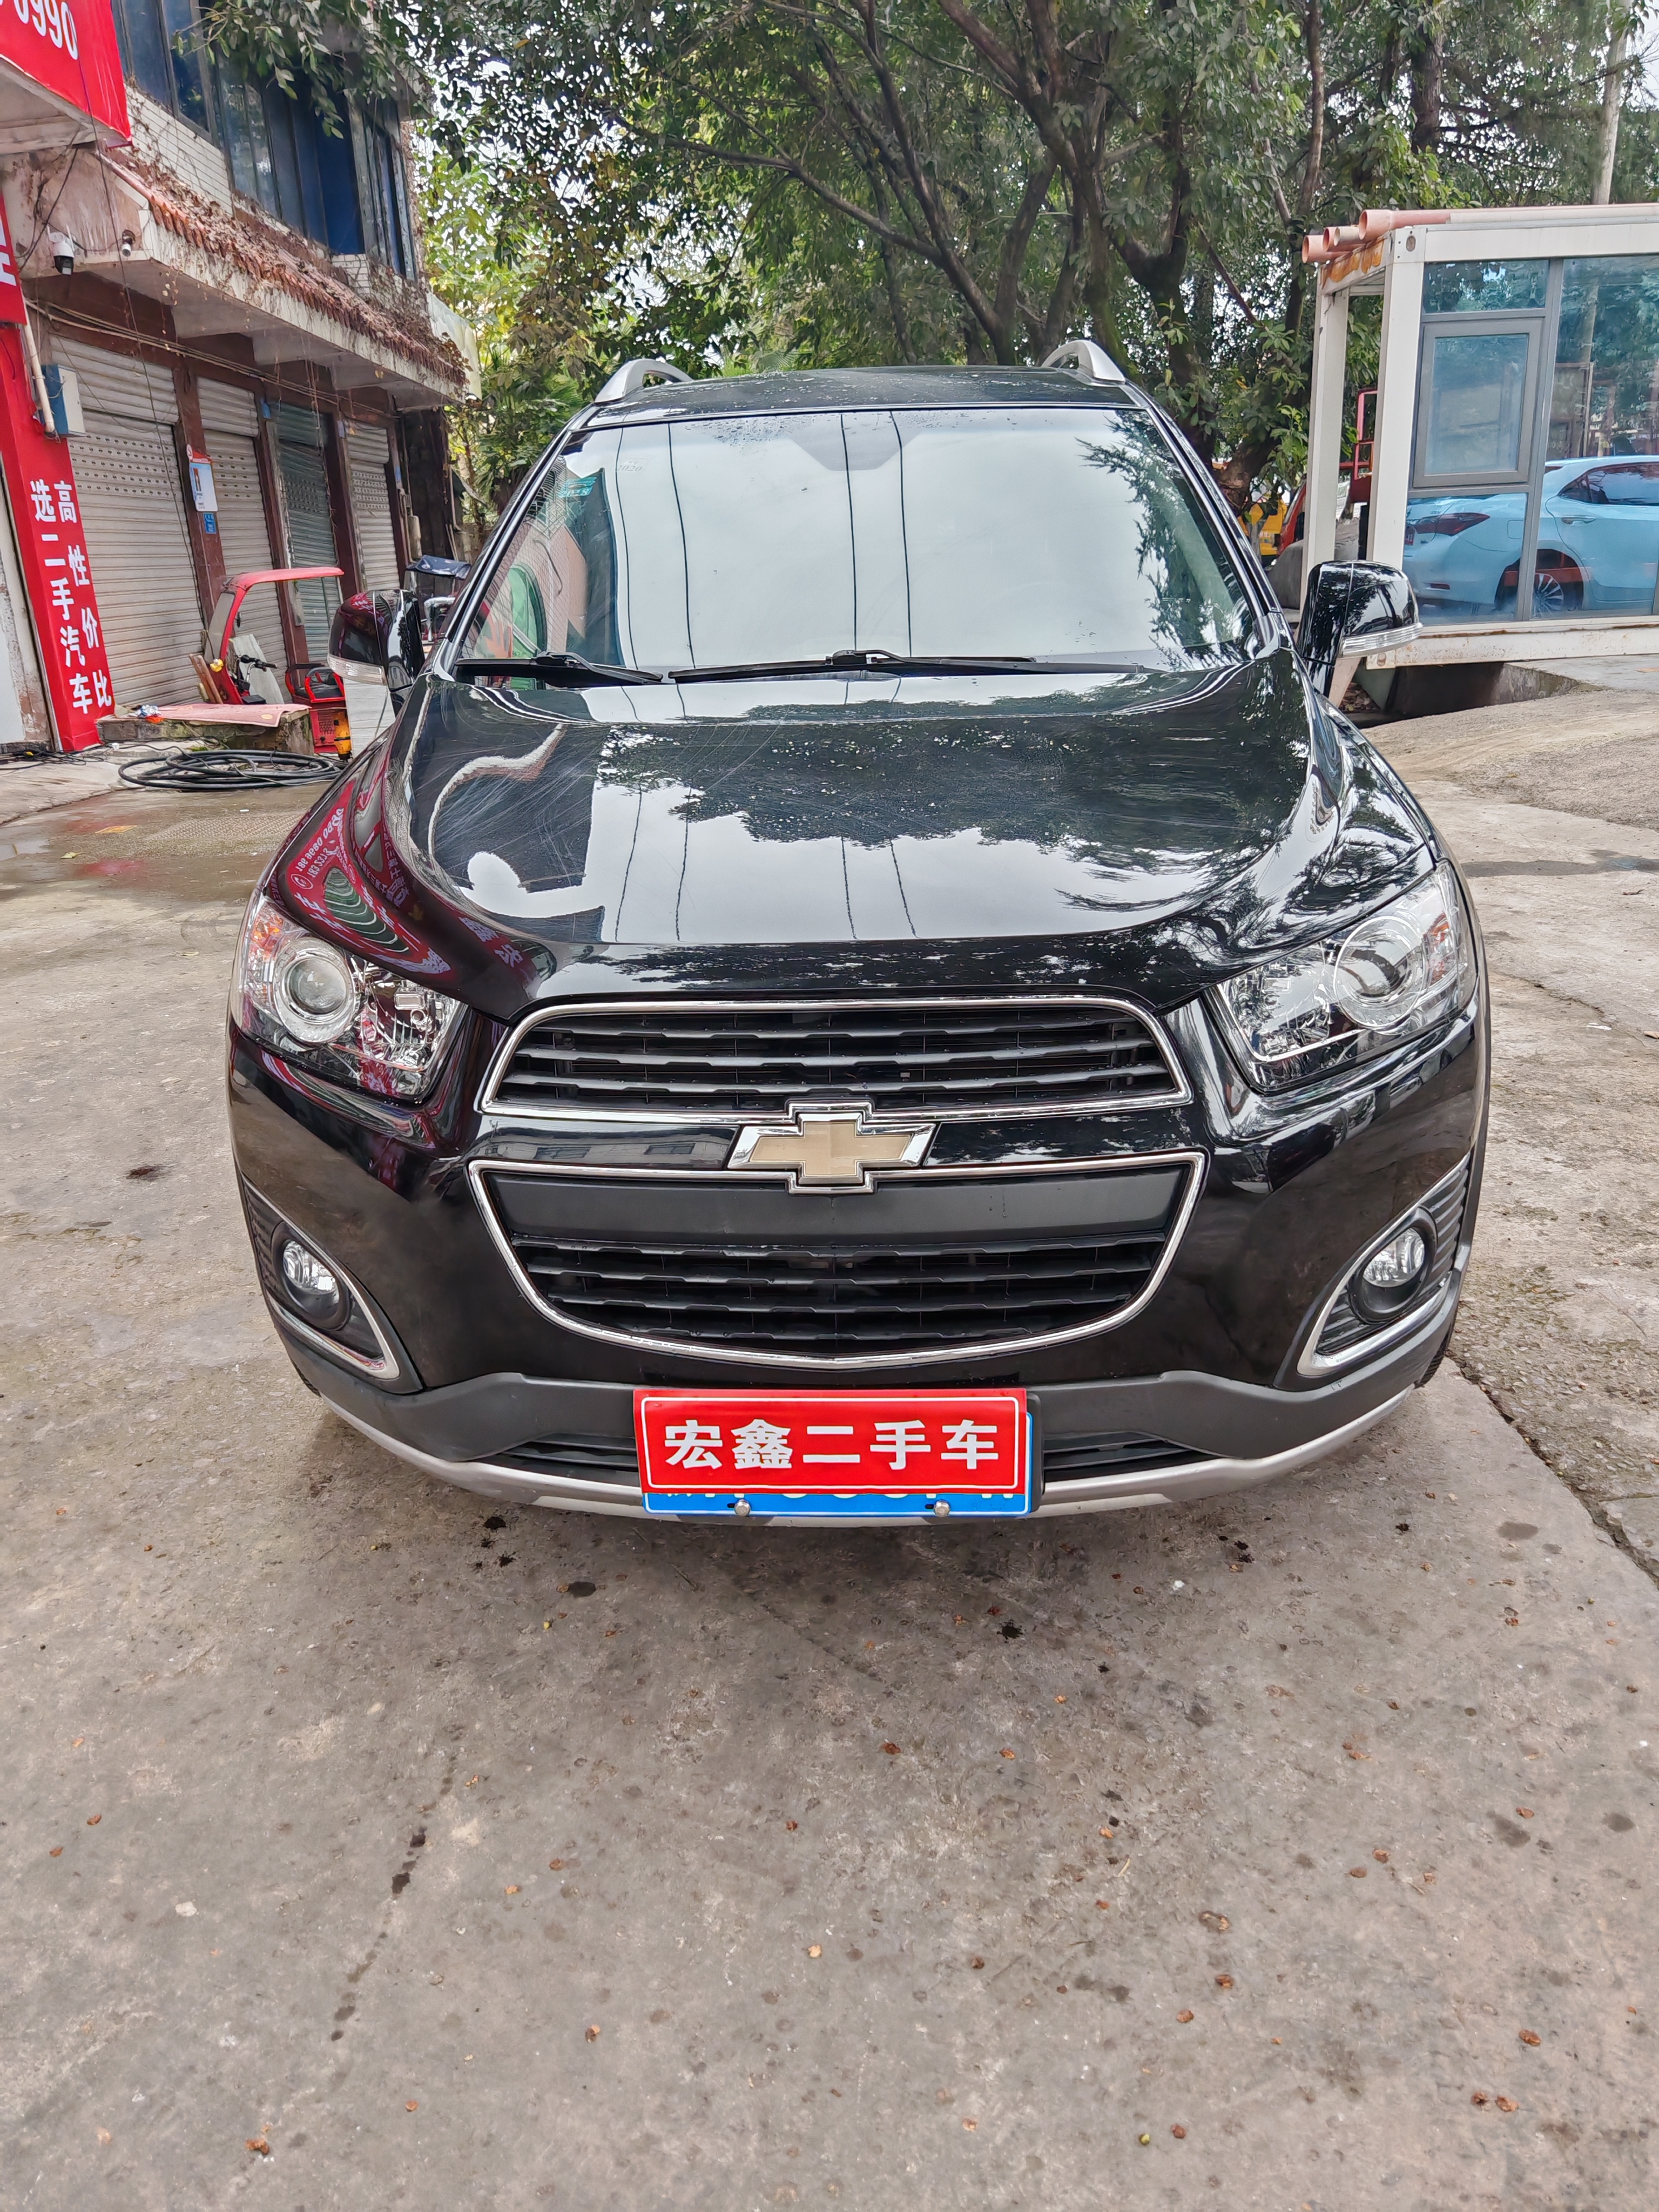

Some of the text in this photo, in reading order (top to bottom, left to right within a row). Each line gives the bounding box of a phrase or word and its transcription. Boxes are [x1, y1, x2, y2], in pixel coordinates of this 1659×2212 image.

[30, 478, 93, 714] 选二手汽车
[53, 480, 112, 708] 高性价比
[664, 1419, 999, 1470] 宏鑫二手车
